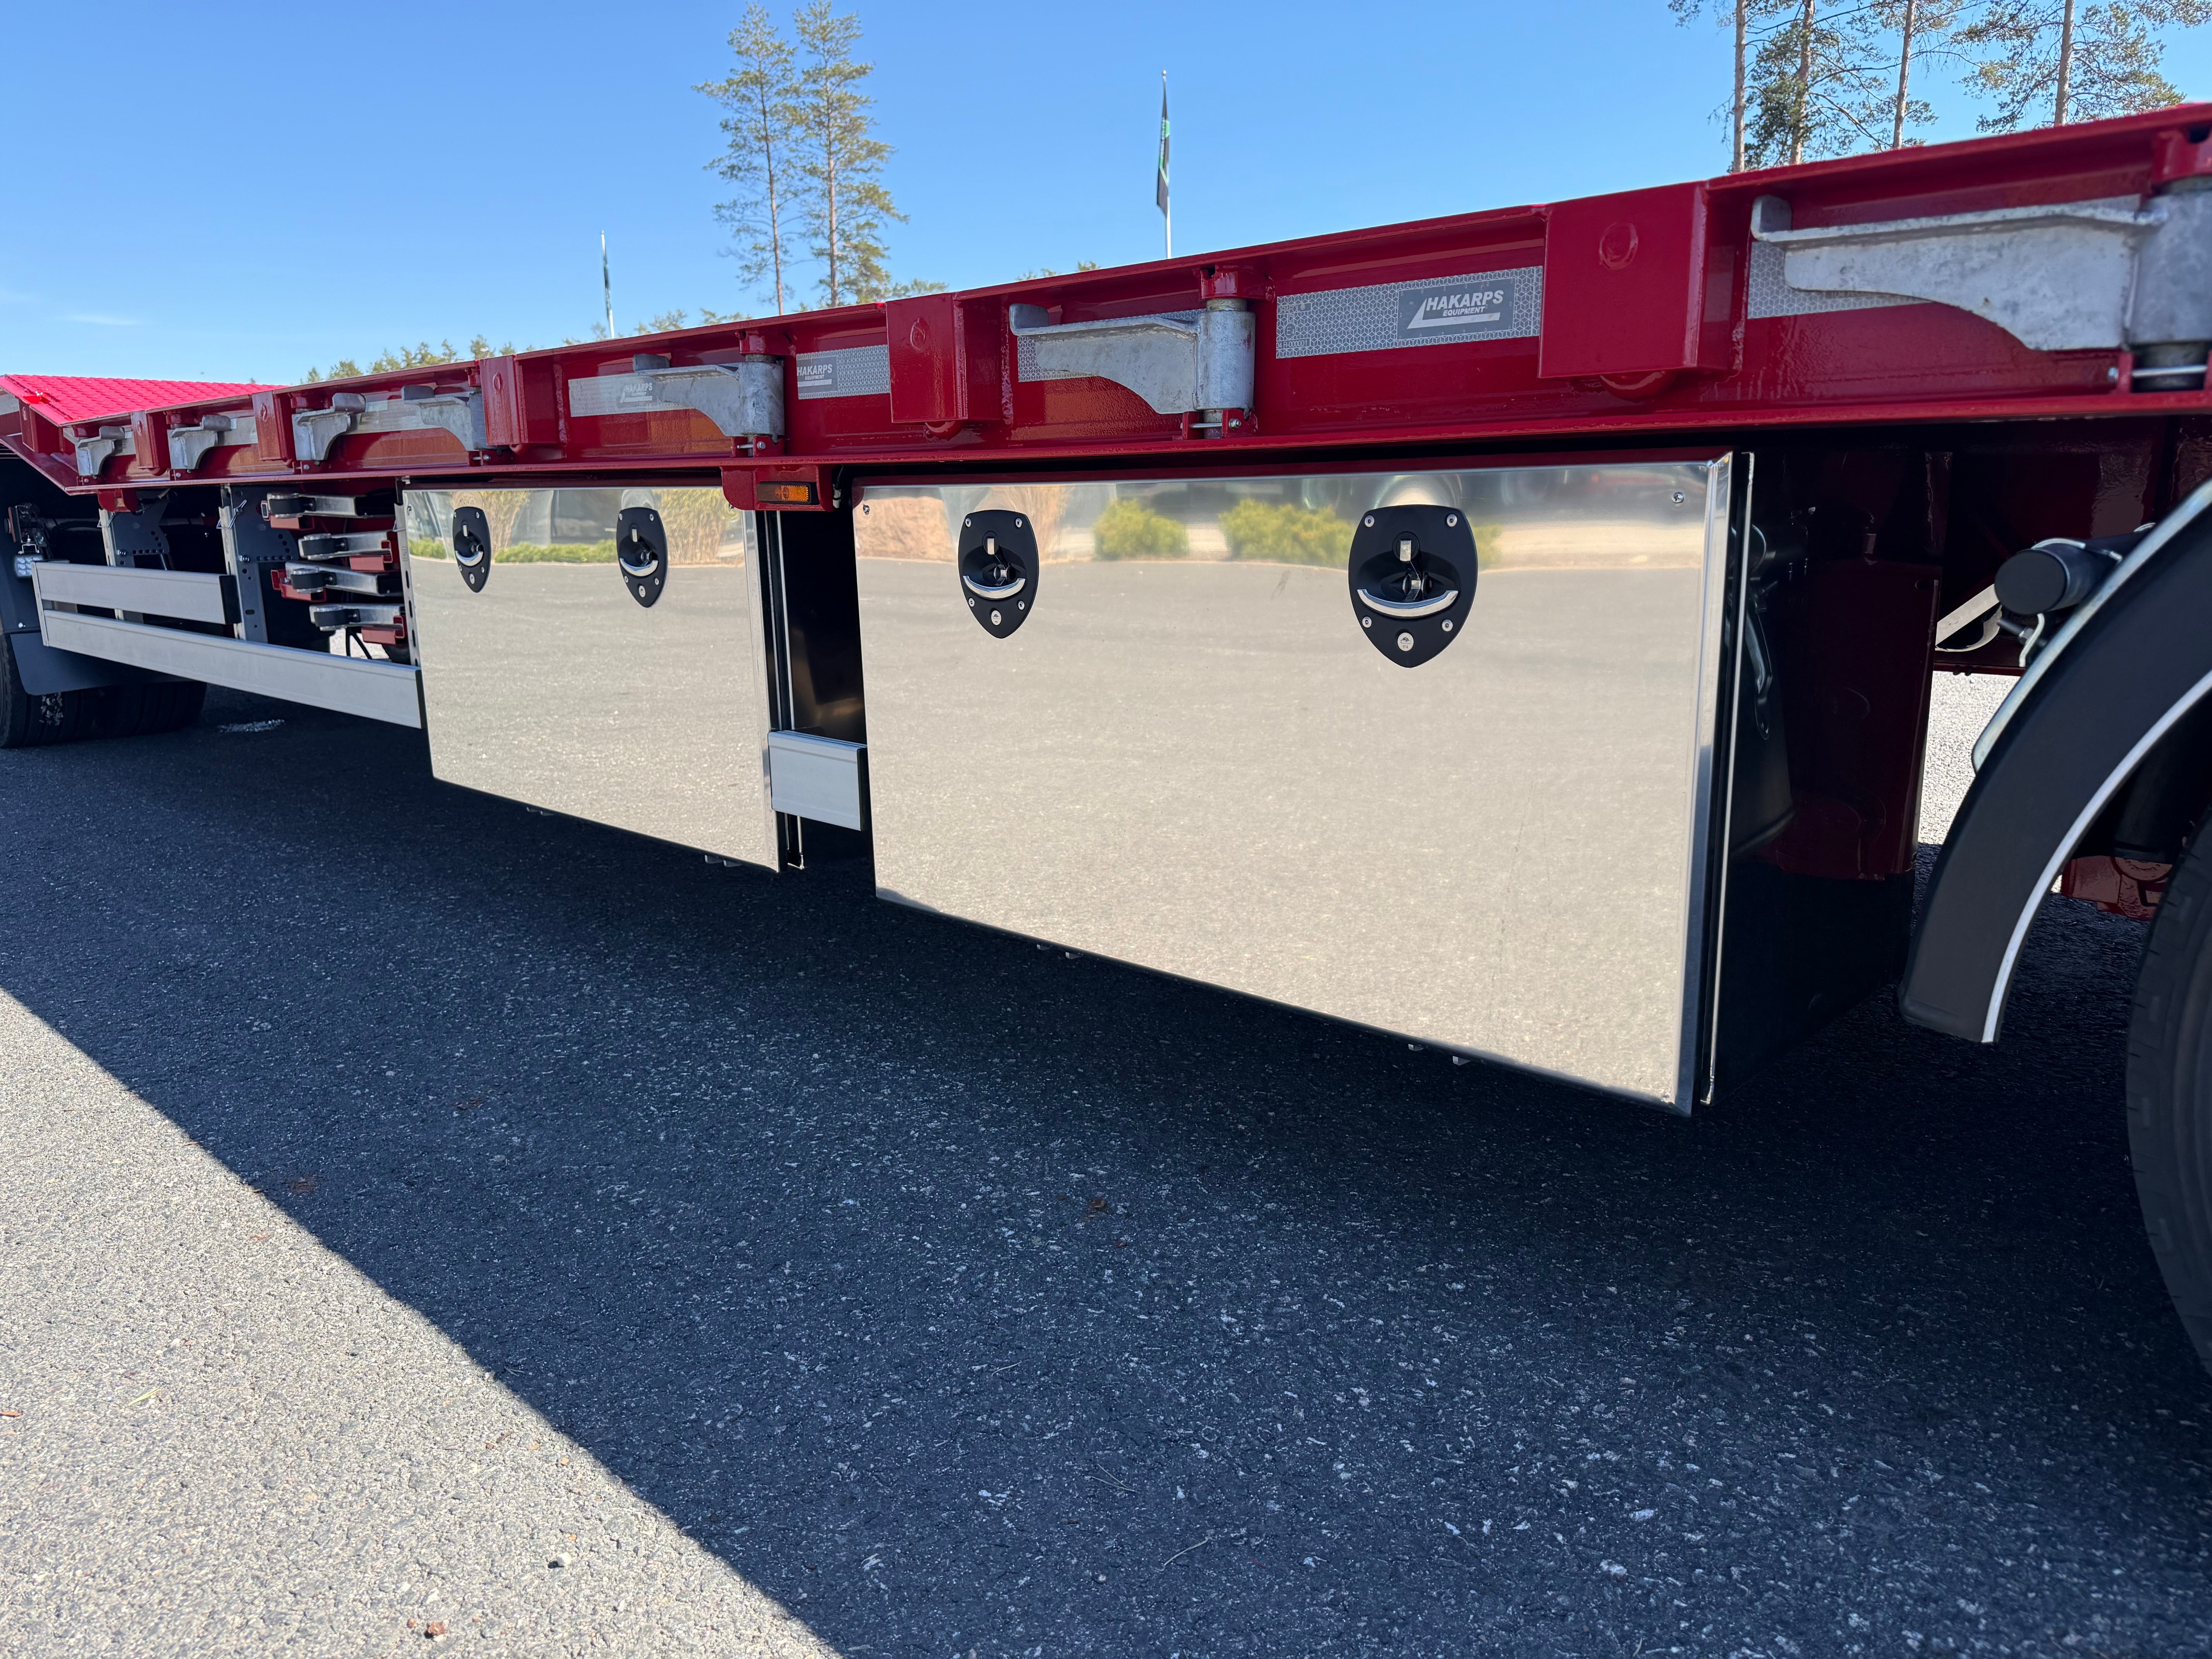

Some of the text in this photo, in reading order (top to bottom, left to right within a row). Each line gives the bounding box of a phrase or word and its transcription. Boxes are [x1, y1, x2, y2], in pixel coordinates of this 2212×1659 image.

[1426, 290, 1504, 311] HAKARPS
[1443, 306, 1486, 316] EQUIPMENT
[797, 364, 833, 376] HAKARPS
[625, 383, 653, 392] HAKARPS
